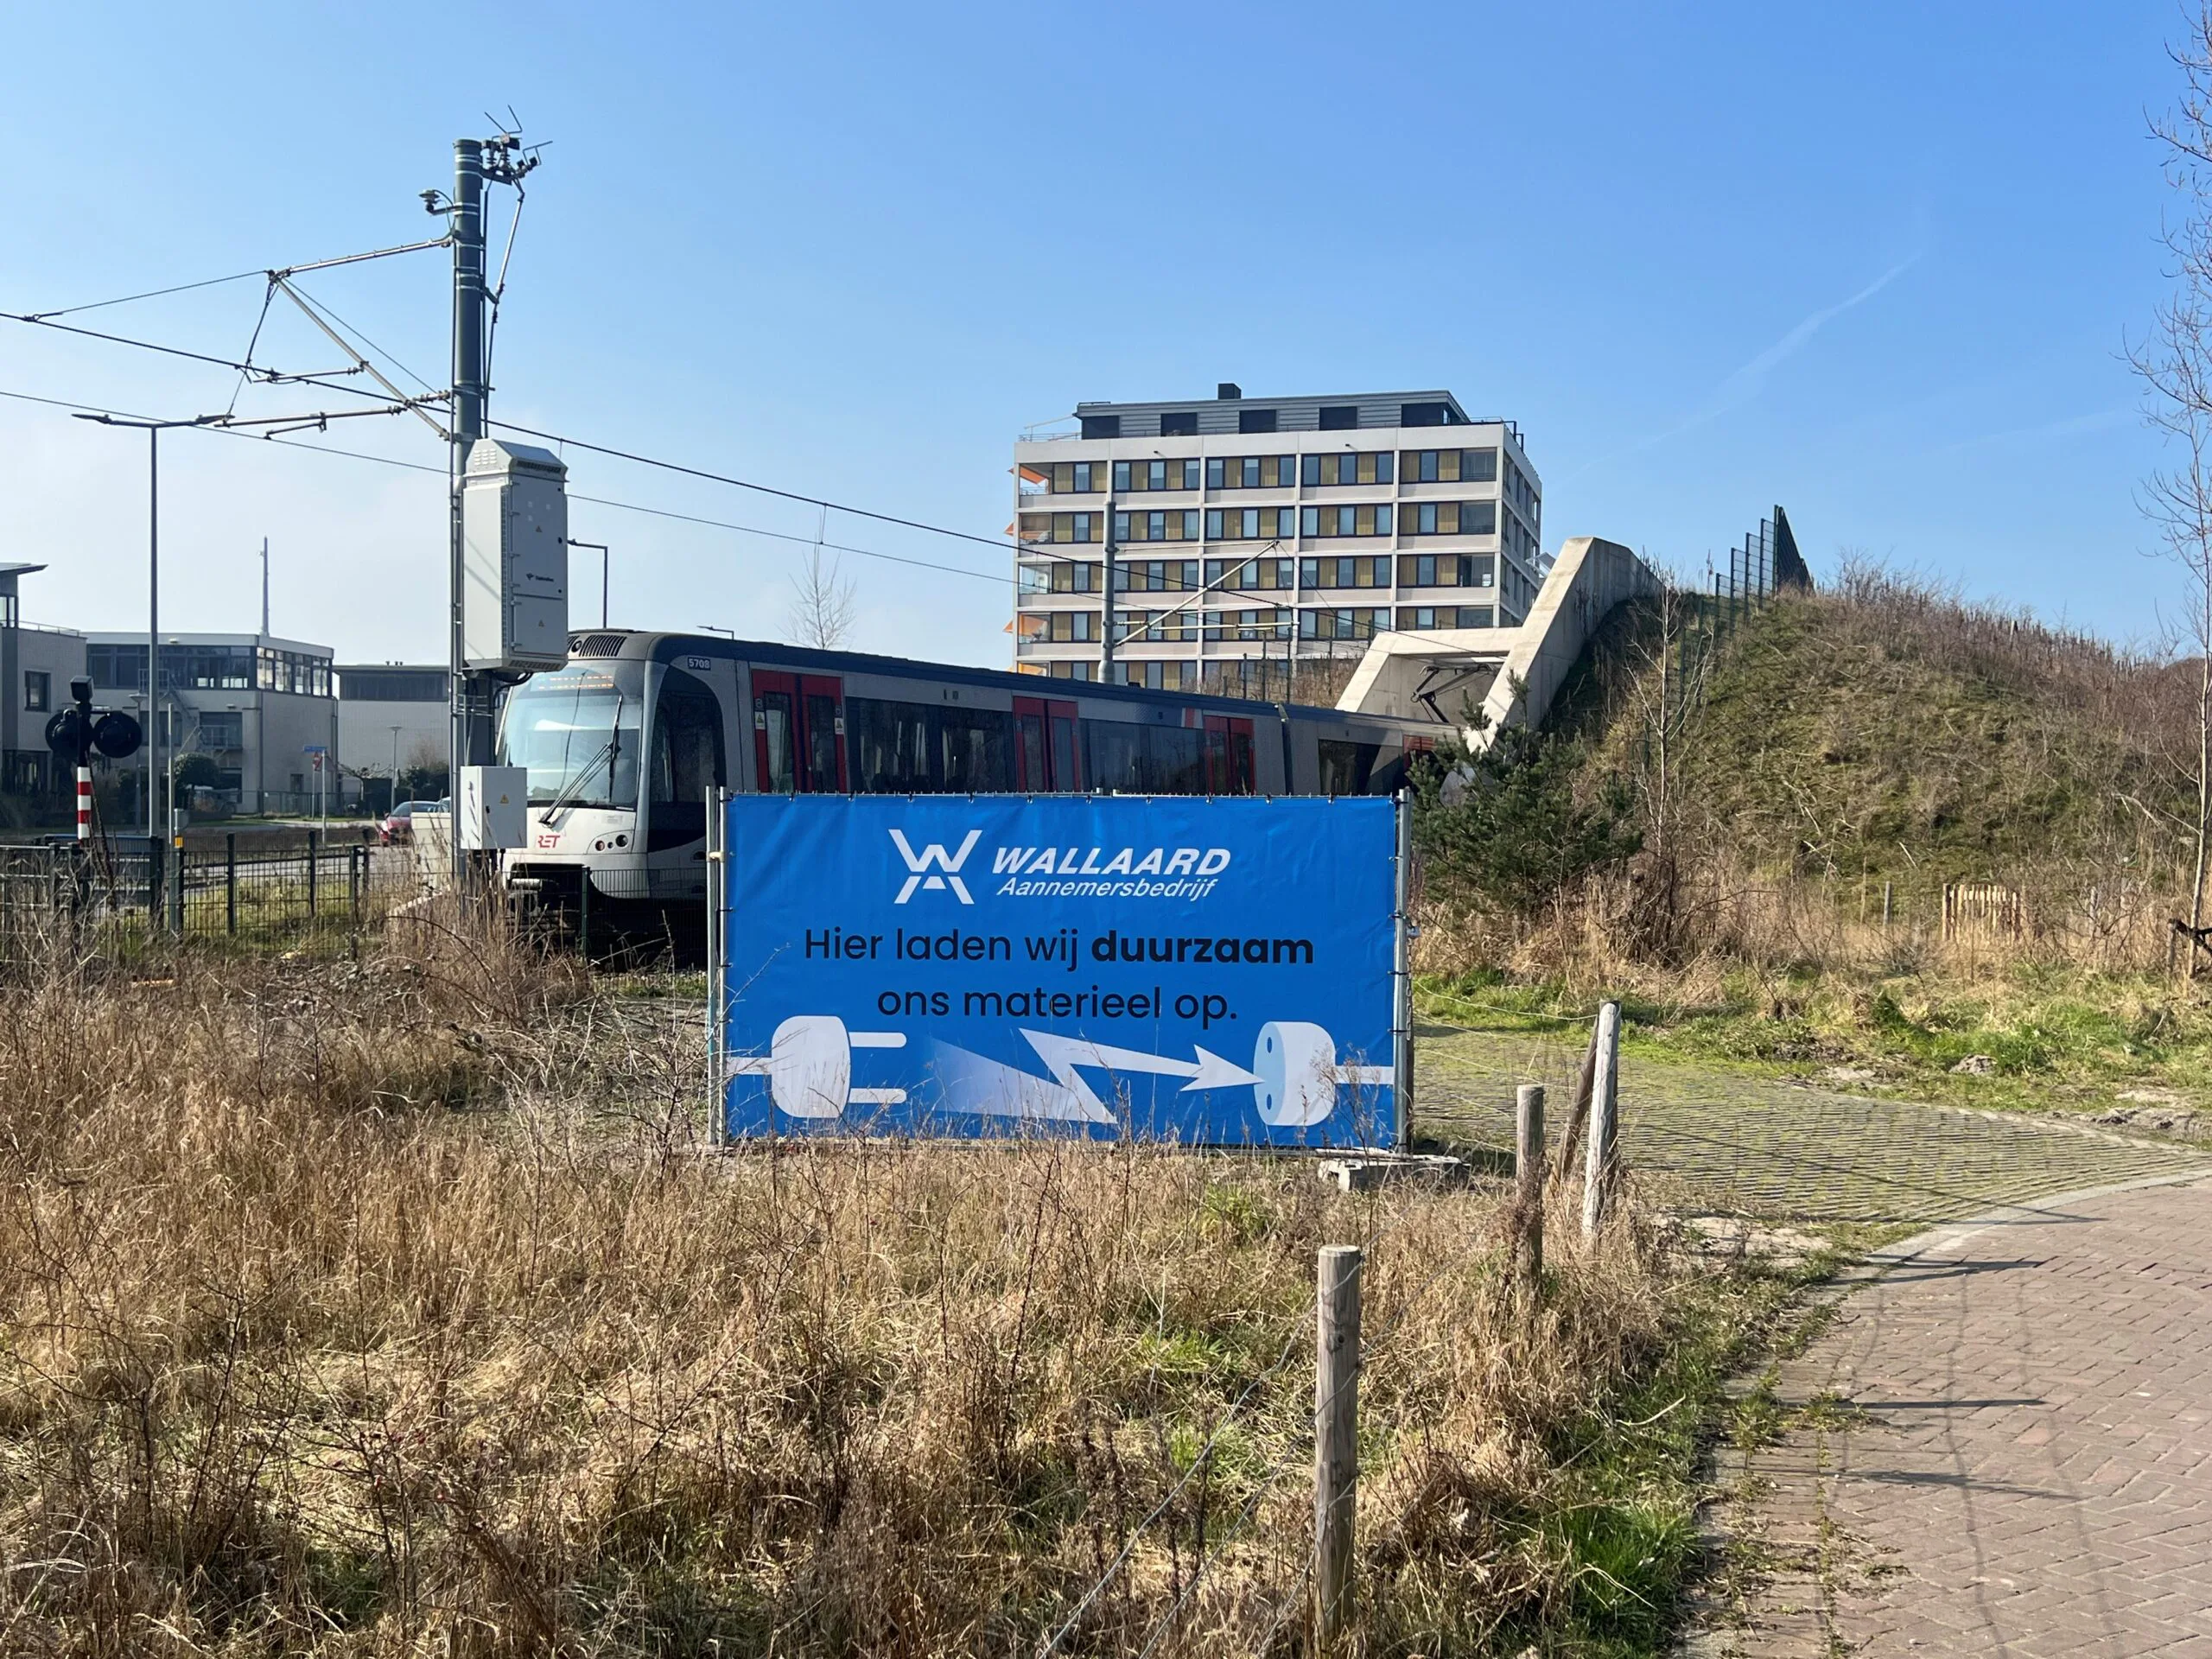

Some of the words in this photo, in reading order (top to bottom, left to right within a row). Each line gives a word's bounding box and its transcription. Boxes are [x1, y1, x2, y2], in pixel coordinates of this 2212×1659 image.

[689, 658, 710, 669] 5708
[537, 835, 561, 849] RET
[992, 848, 1231, 875] WALLAARD
[997, 877, 1218, 902] Aannemersbedrijf
[804, 928, 883, 960] Hier
[896, 928, 1012, 962] laden
[1024, 928, 1079, 973] wij
[1091, 930, 1315, 965] duurzaam
[877, 990, 950, 1018] ons
[963, 984, 1161, 1020] materieel
[1174, 995, 1238, 1031] op.
